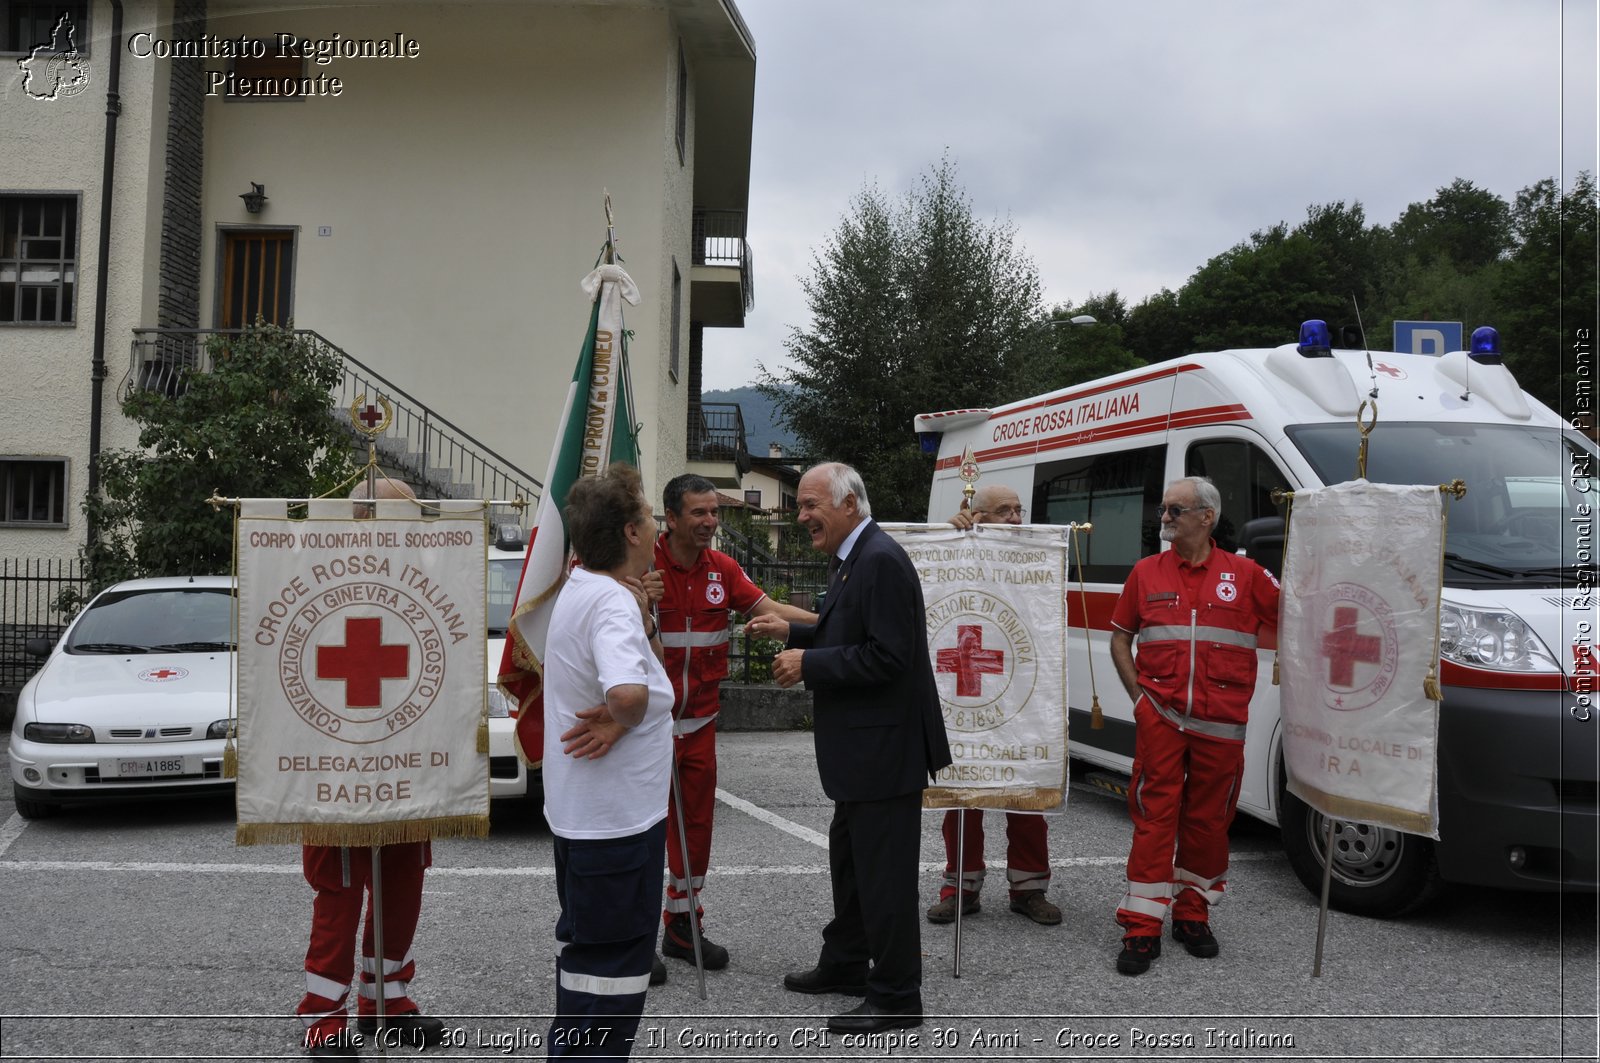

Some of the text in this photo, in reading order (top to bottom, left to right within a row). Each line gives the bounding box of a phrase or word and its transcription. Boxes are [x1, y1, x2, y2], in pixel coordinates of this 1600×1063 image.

[593, 330, 614, 387] CUNEO
[992, 392, 1140, 443] CROCE ROSSA ITALIANA
[249, 530, 474, 549] CORPO VOLONTARI DEL SOCCORSO
[924, 549, 977, 562] VOLONTARI
[979, 549, 997, 562] DEL
[998, 550, 1047, 564] SOCCORSO
[937, 567, 986, 584] ROSSA
[992, 567, 1055, 585] ITALIANA
[254, 554, 470, 647] CROCE ROSSA ITALIANA
[980, 598, 996, 616] DI
[997, 609, 1033, 665] GINEVRA
[283, 585, 442, 734] CONVENZIONE DI GINEVRA 22 AGOSTO 1864
[971, 743, 1028, 760] LOCALE
[1034, 745, 1048, 760] DI
[1338, 735, 1402, 758] LOCALE
[1407, 745, 1423, 761] DI
[120, 760, 182, 774] CRI A1885
[278, 751, 449, 773] DELEGAZIONE DI
[316, 779, 412, 803] BARGE
